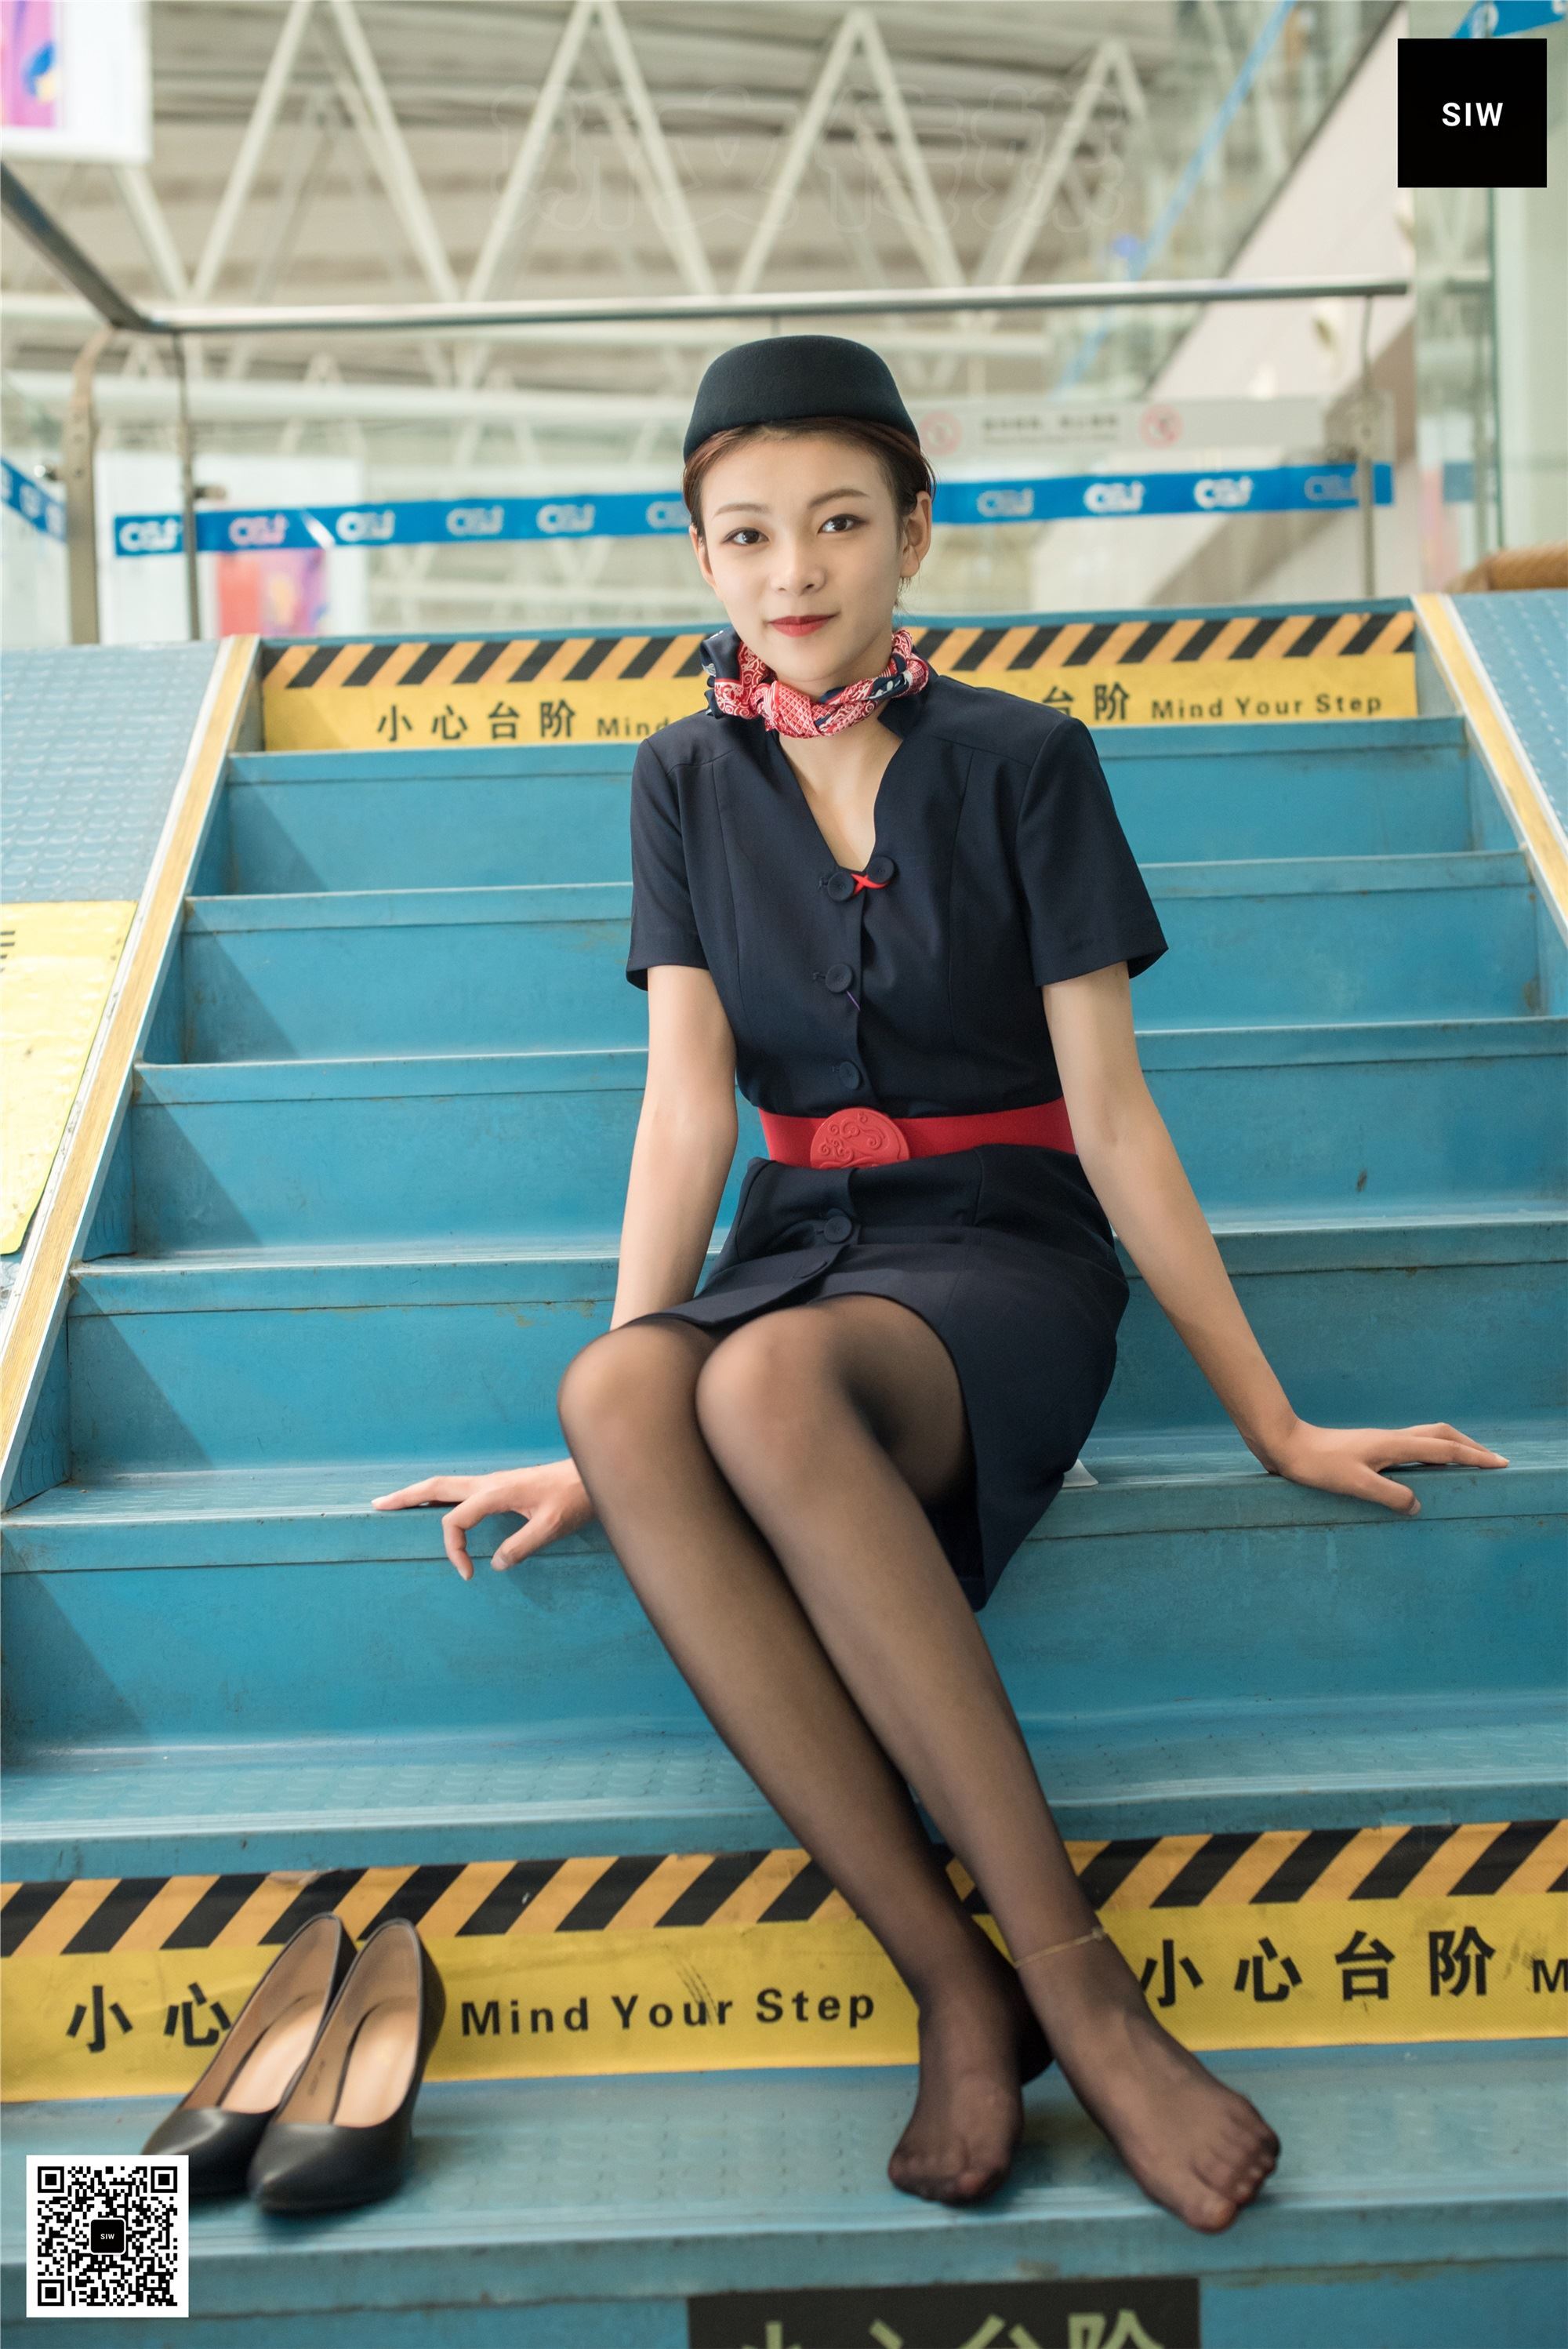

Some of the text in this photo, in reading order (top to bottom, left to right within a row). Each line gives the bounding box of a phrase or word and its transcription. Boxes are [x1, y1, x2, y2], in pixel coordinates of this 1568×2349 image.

[377, 699, 576, 742] 小心台阶
[1151, 698, 1223, 719] Mind
[1236, 697, 1302, 717] Your
[1316, 693, 1382, 713] Step
[1142, 1926, 1496, 2008] 小心台阶
[66, 1980, 874, 2053] 小心 Mind Your Step
